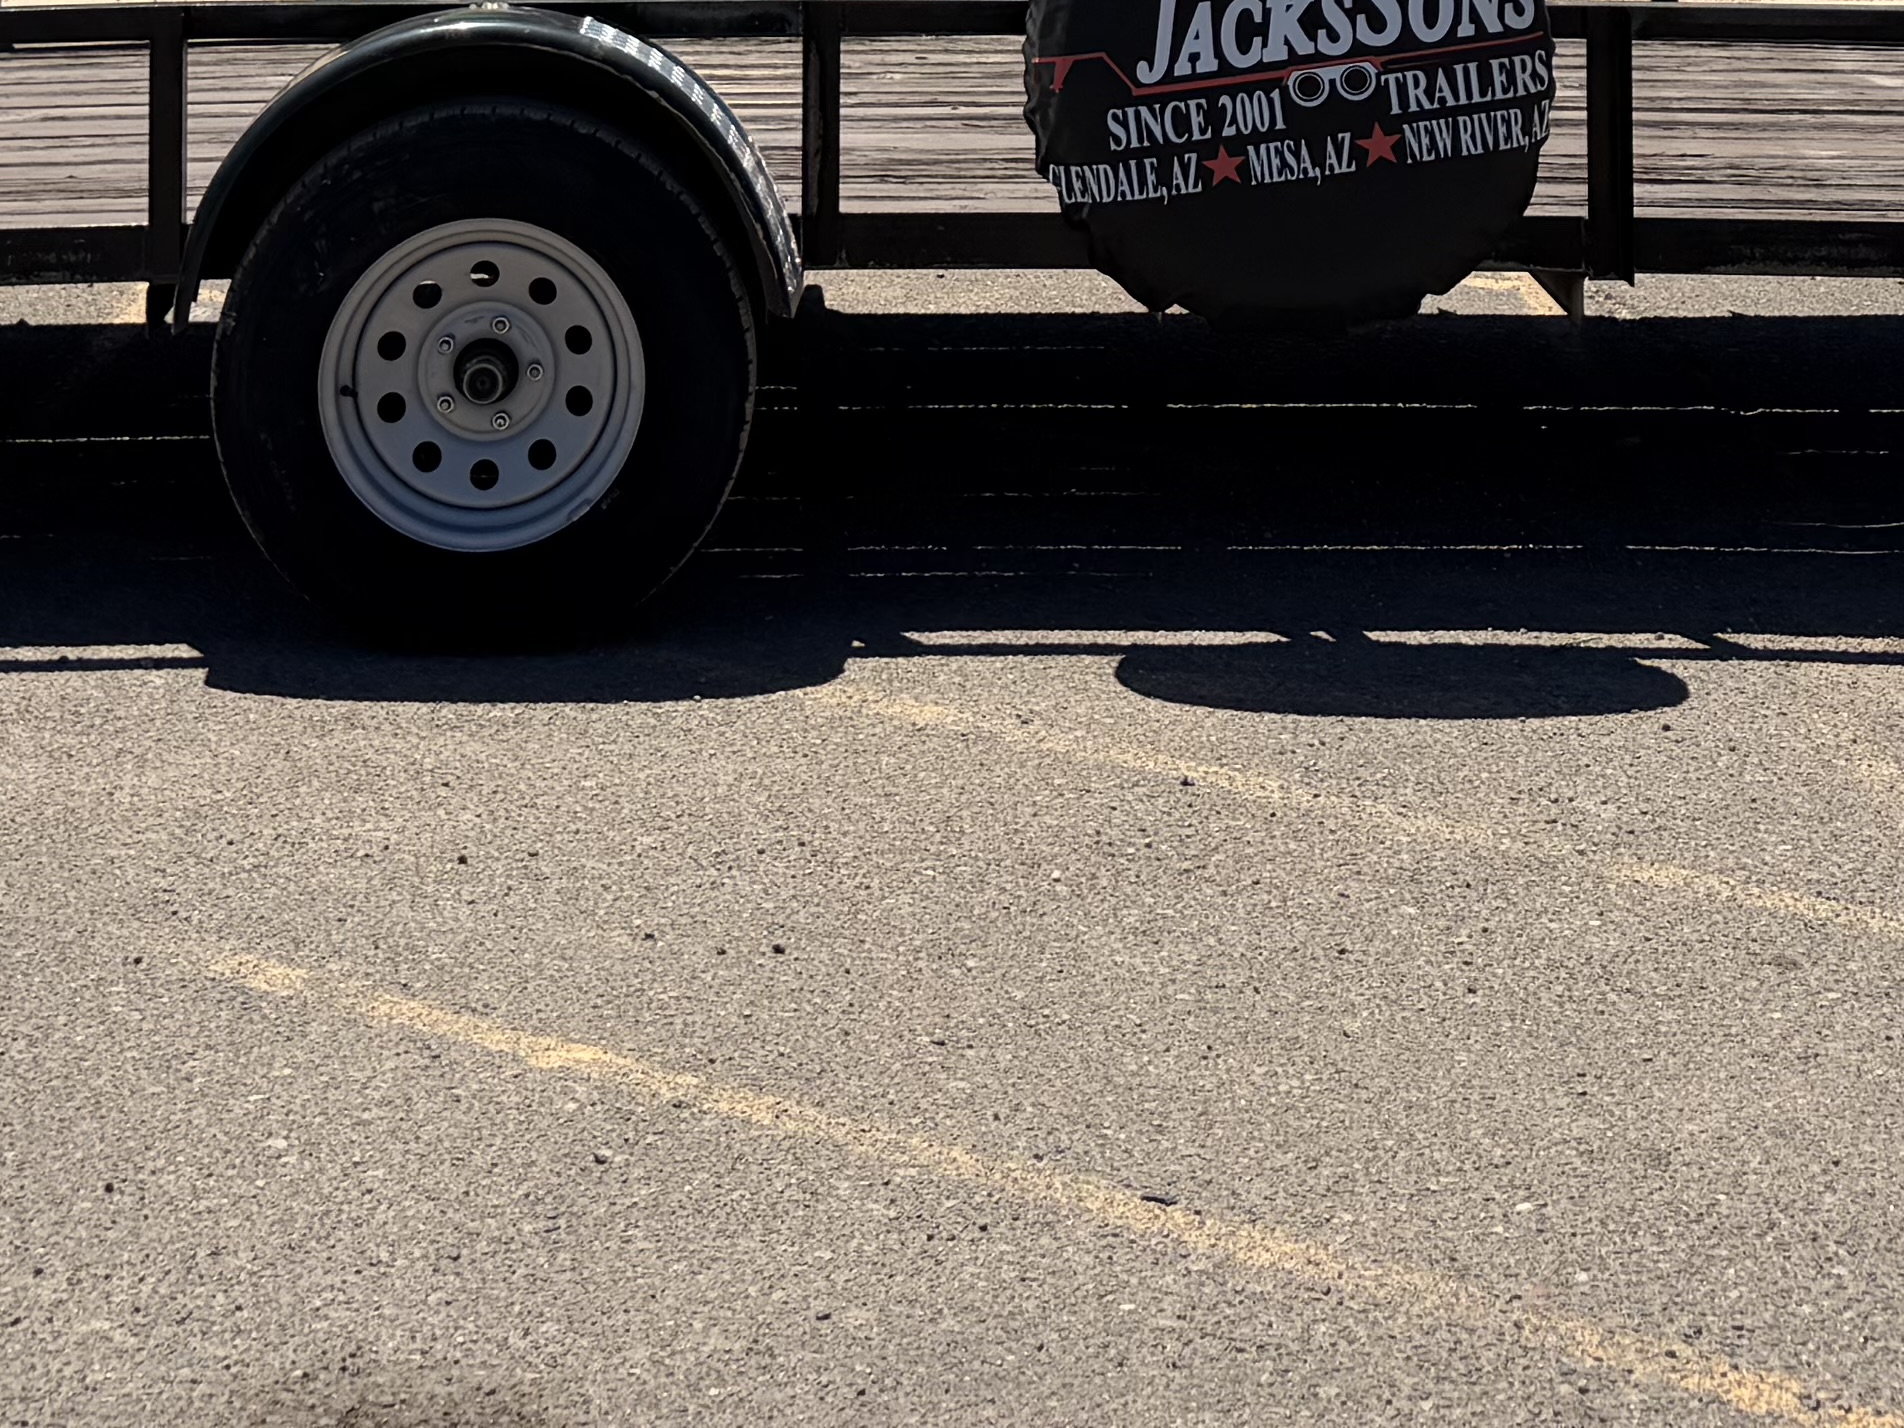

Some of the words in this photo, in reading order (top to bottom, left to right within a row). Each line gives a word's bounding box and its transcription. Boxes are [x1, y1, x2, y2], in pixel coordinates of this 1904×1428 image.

[1380, 49, 1550, 115] TRAILERS
[1106, 97, 1212, 152] SINCE
[1221, 88, 1287, 137] 2001
[1171, 152, 1203, 197] AZ
[1247, 138, 1322, 186] MESA,
[1324, 131, 1357, 175] AZ
[1401, 117, 1454, 164] NEW
[1457, 108, 1530, 154] RIVER,
